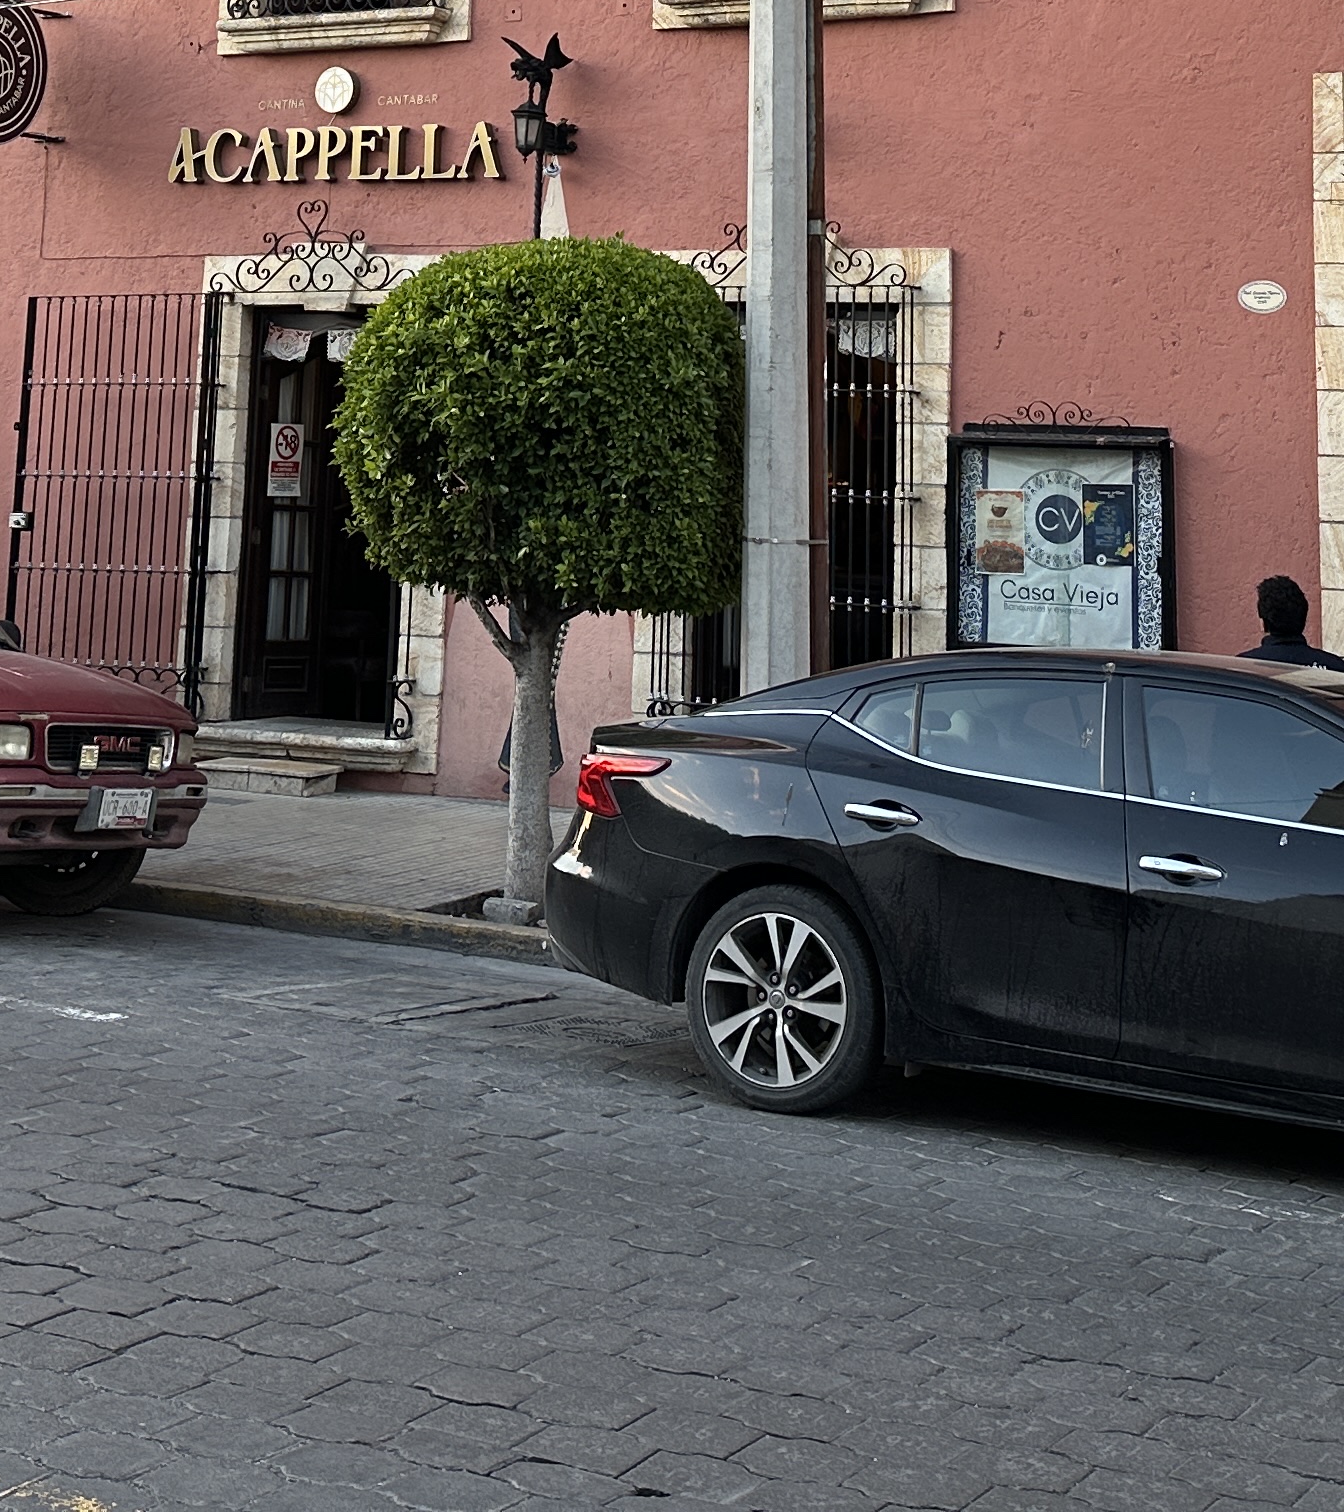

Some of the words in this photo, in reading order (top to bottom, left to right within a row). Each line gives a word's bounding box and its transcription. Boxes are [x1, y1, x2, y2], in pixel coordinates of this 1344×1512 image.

[258, 98, 305, 111] CANTINA
[377, 93, 438, 107] CANTABAR
[1039, 507, 1080, 532] CV
[1000, 579, 1055, 601] Casa
[1062, 582, 1119, 612] Vieja
[94, 736, 141, 752] GMC
